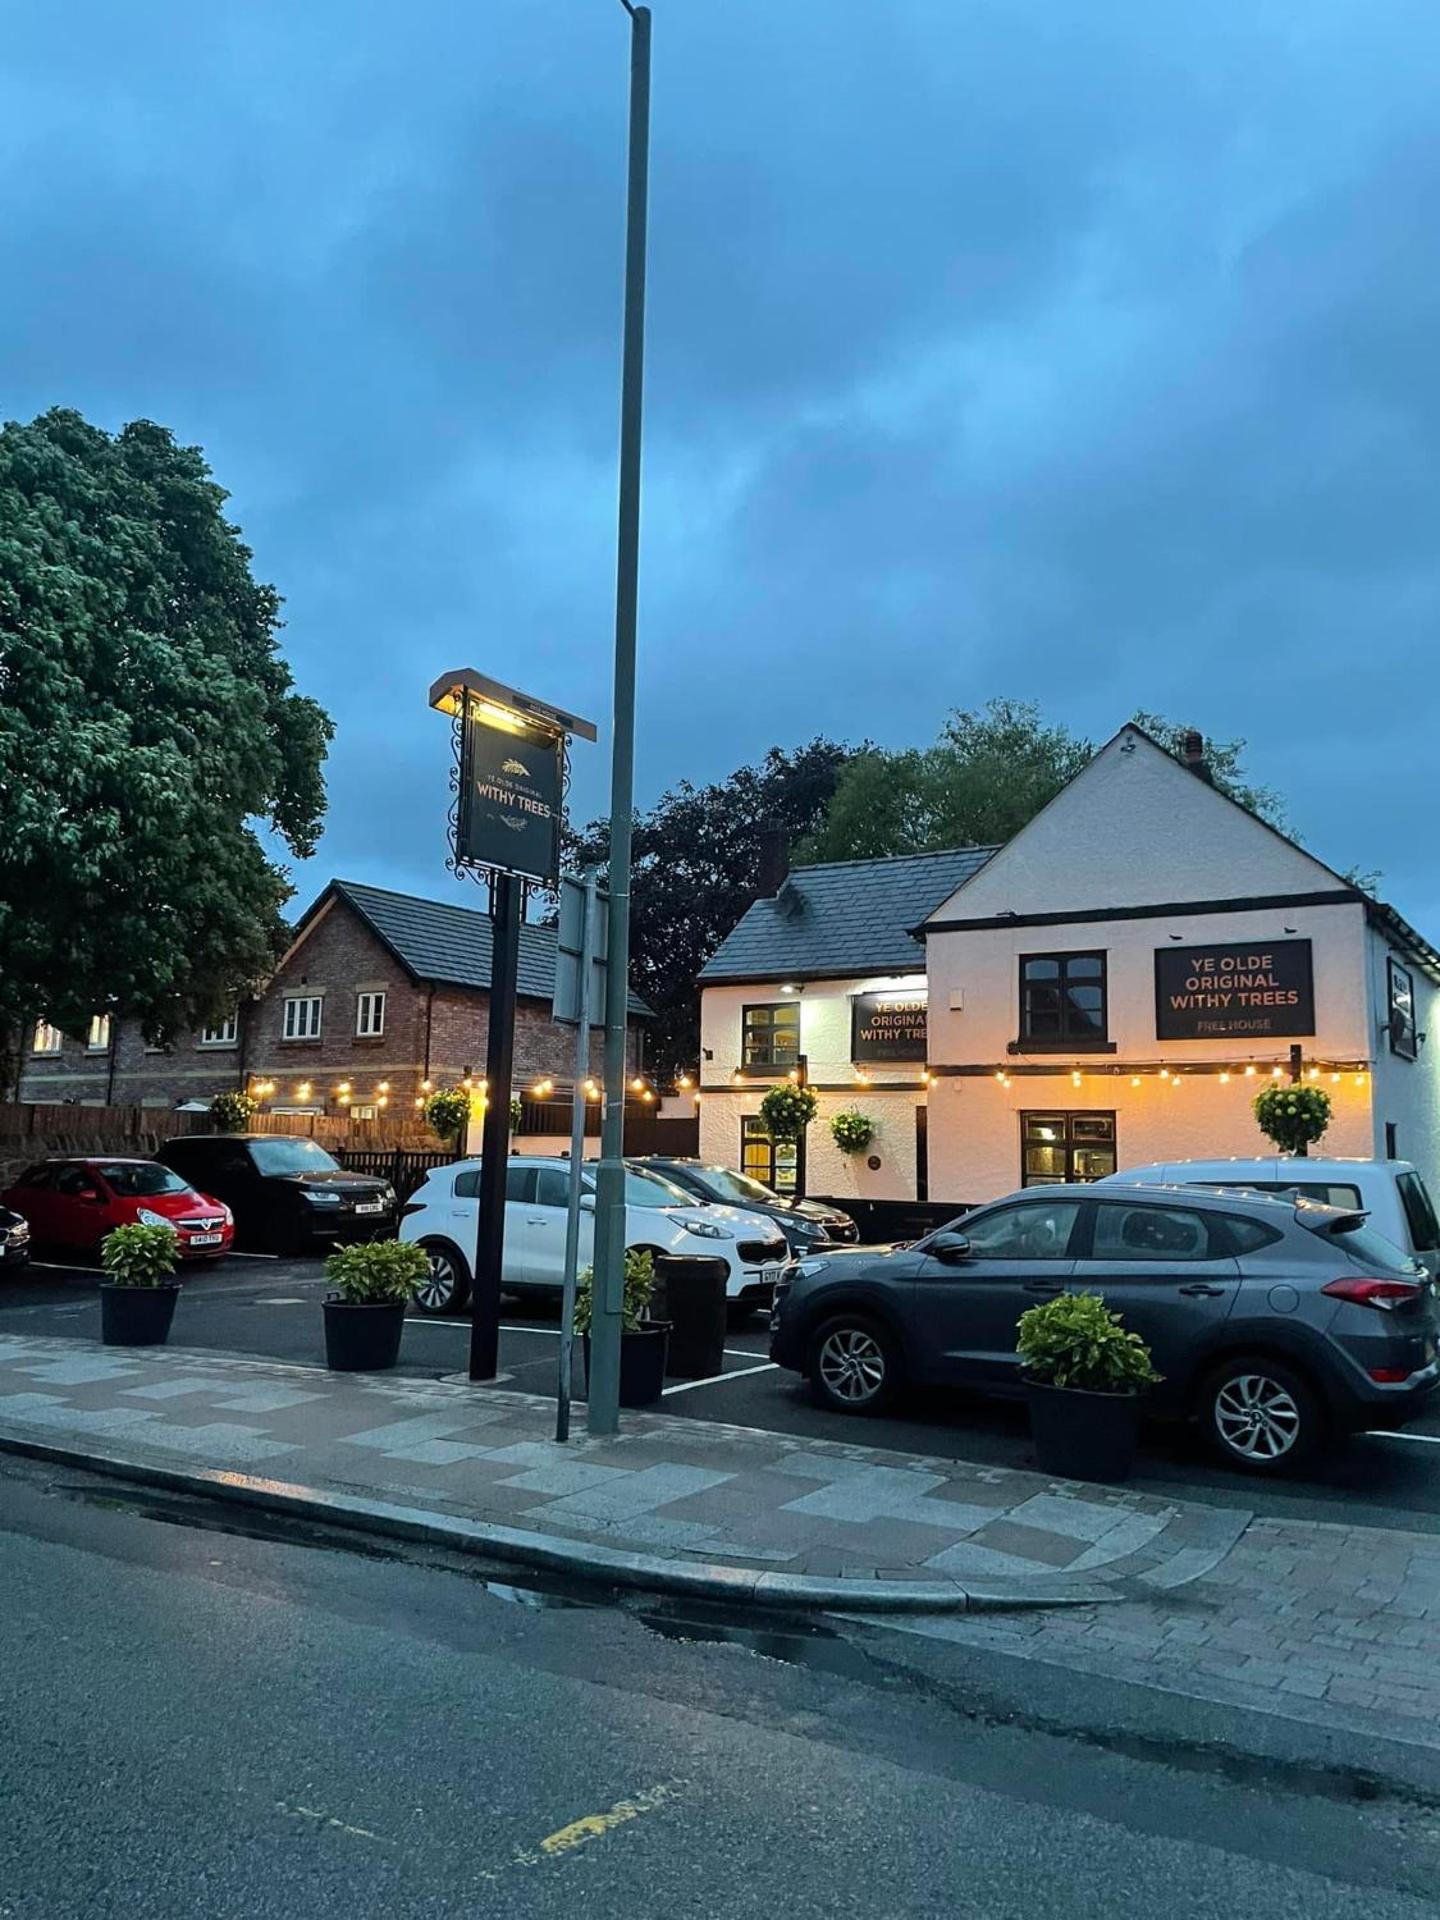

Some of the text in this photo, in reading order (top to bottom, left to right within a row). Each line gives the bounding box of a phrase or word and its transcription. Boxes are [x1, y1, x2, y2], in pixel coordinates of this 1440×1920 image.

[477, 781, 551, 818] WITHY TREES
[1192, 955, 1273, 972] YE OLDE
[1185, 973, 1280, 991] ORIGINAL
[875, 1000, 928, 1013] YE OLDE
[1170, 991, 1299, 1009] WITHY TREES
[871, 1015, 928, 1026] ORIGINA
[1197, 1018, 1272, 1032] FREE HOUSE
[860, 1028, 928, 1040] WITHY TRE
